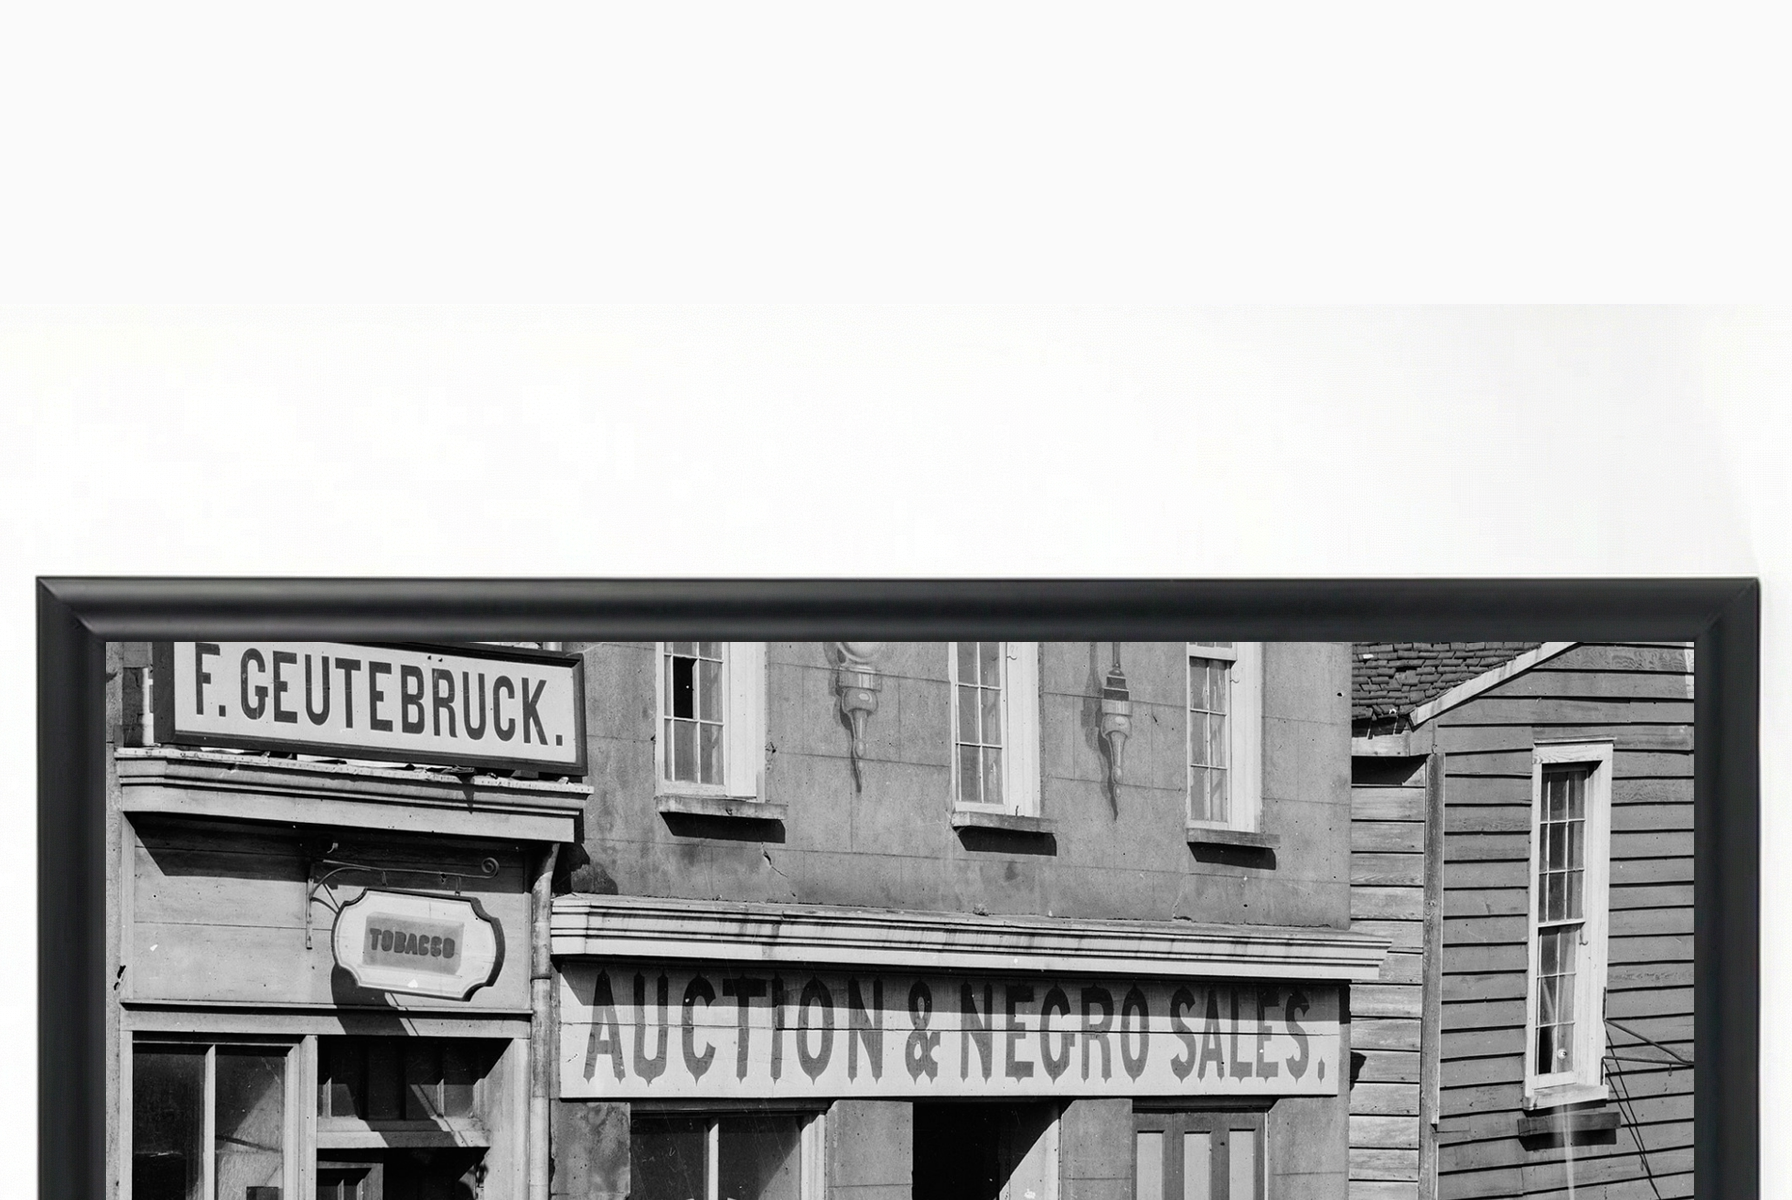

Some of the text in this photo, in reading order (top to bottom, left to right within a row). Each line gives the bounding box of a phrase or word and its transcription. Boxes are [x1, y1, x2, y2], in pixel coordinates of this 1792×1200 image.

[195, 642, 563, 747] F. GEUTEBRUCK.
[369, 927, 456, 959] TOBACCO
[583, 967, 1325, 1087] AUCTION & NEGRO SALES.
